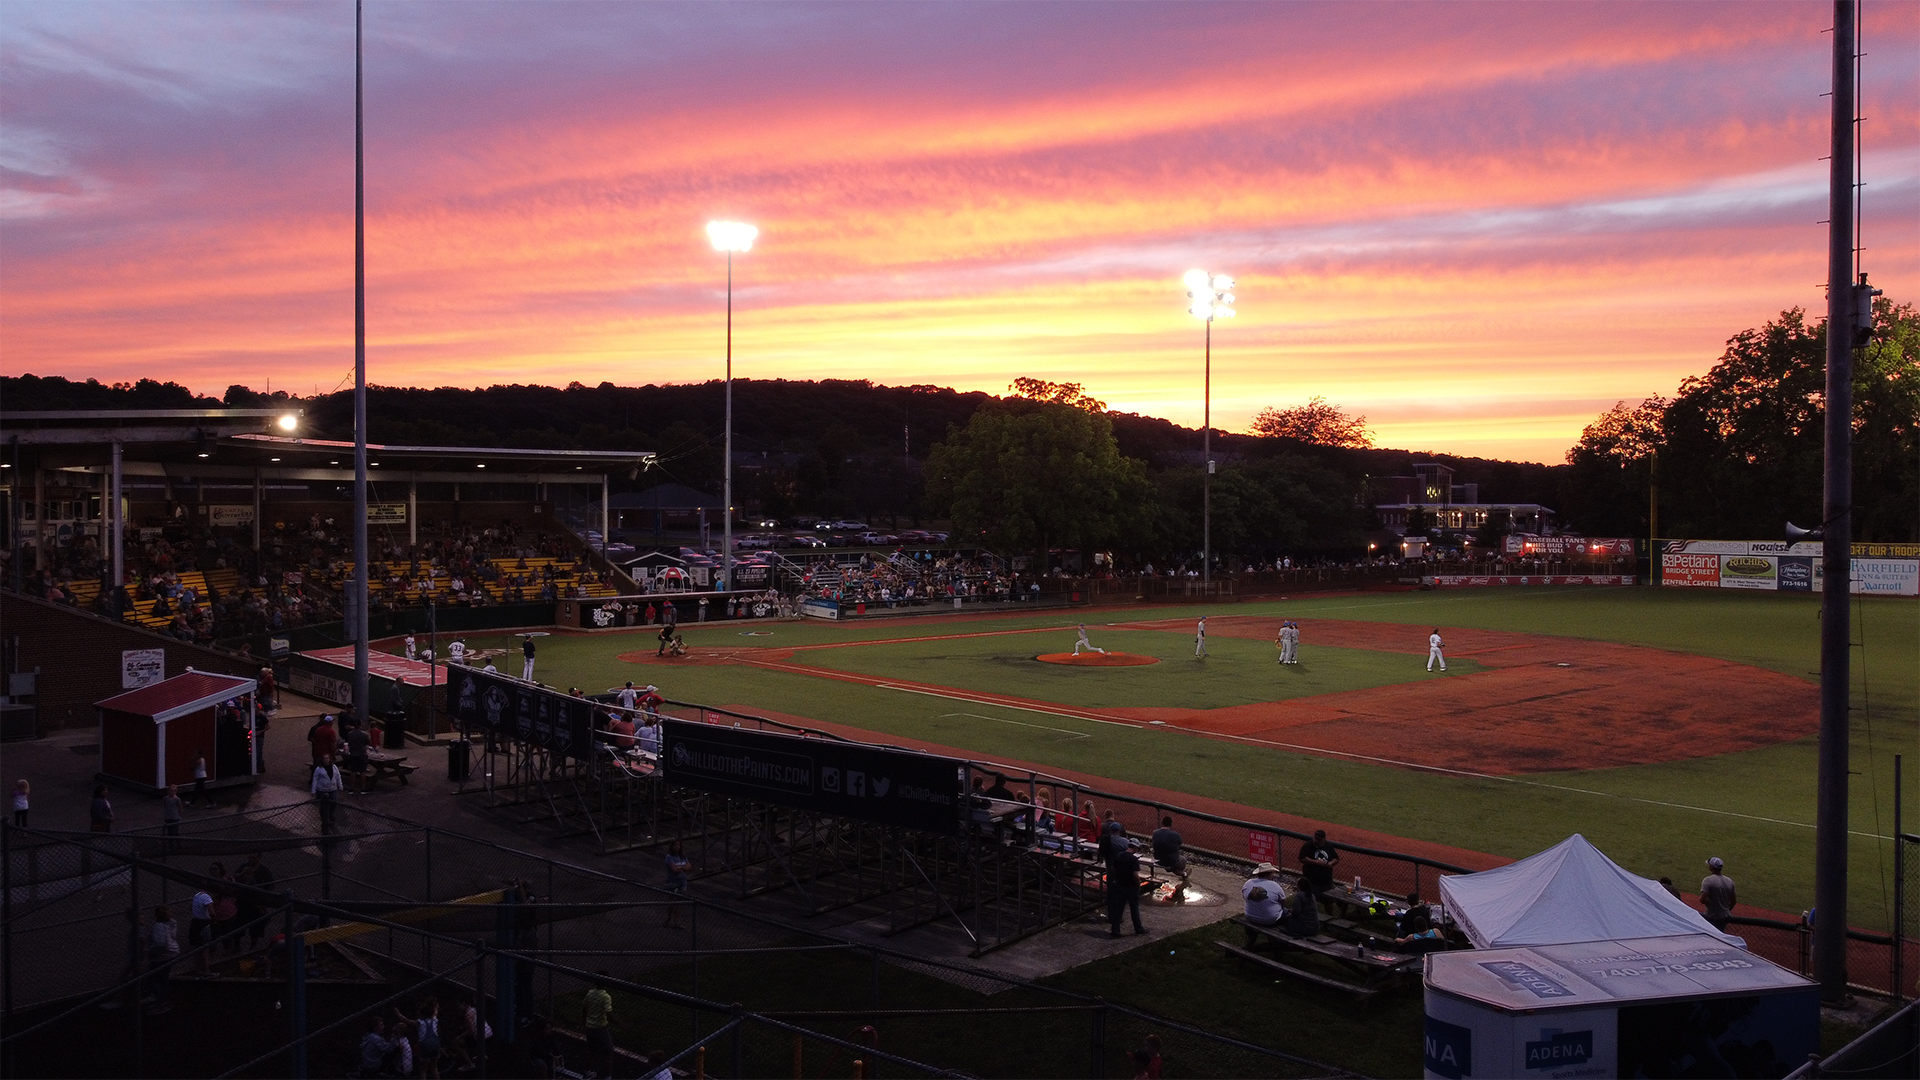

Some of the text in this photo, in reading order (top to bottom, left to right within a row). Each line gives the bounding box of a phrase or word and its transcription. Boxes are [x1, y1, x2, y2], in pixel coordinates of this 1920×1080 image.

[1868, 546, 1887, 556] OUR
[1674, 554, 1718, 568] Petland
[1851, 560, 1917, 573] FAIRFIELD
[1861, 582, 1902, 590] Marriott
[1502, 963, 1562, 995] ADENA
[1529, 1043, 1586, 1061] ADENA
[1552, 1067, 1607, 1080] Sports Medicine
